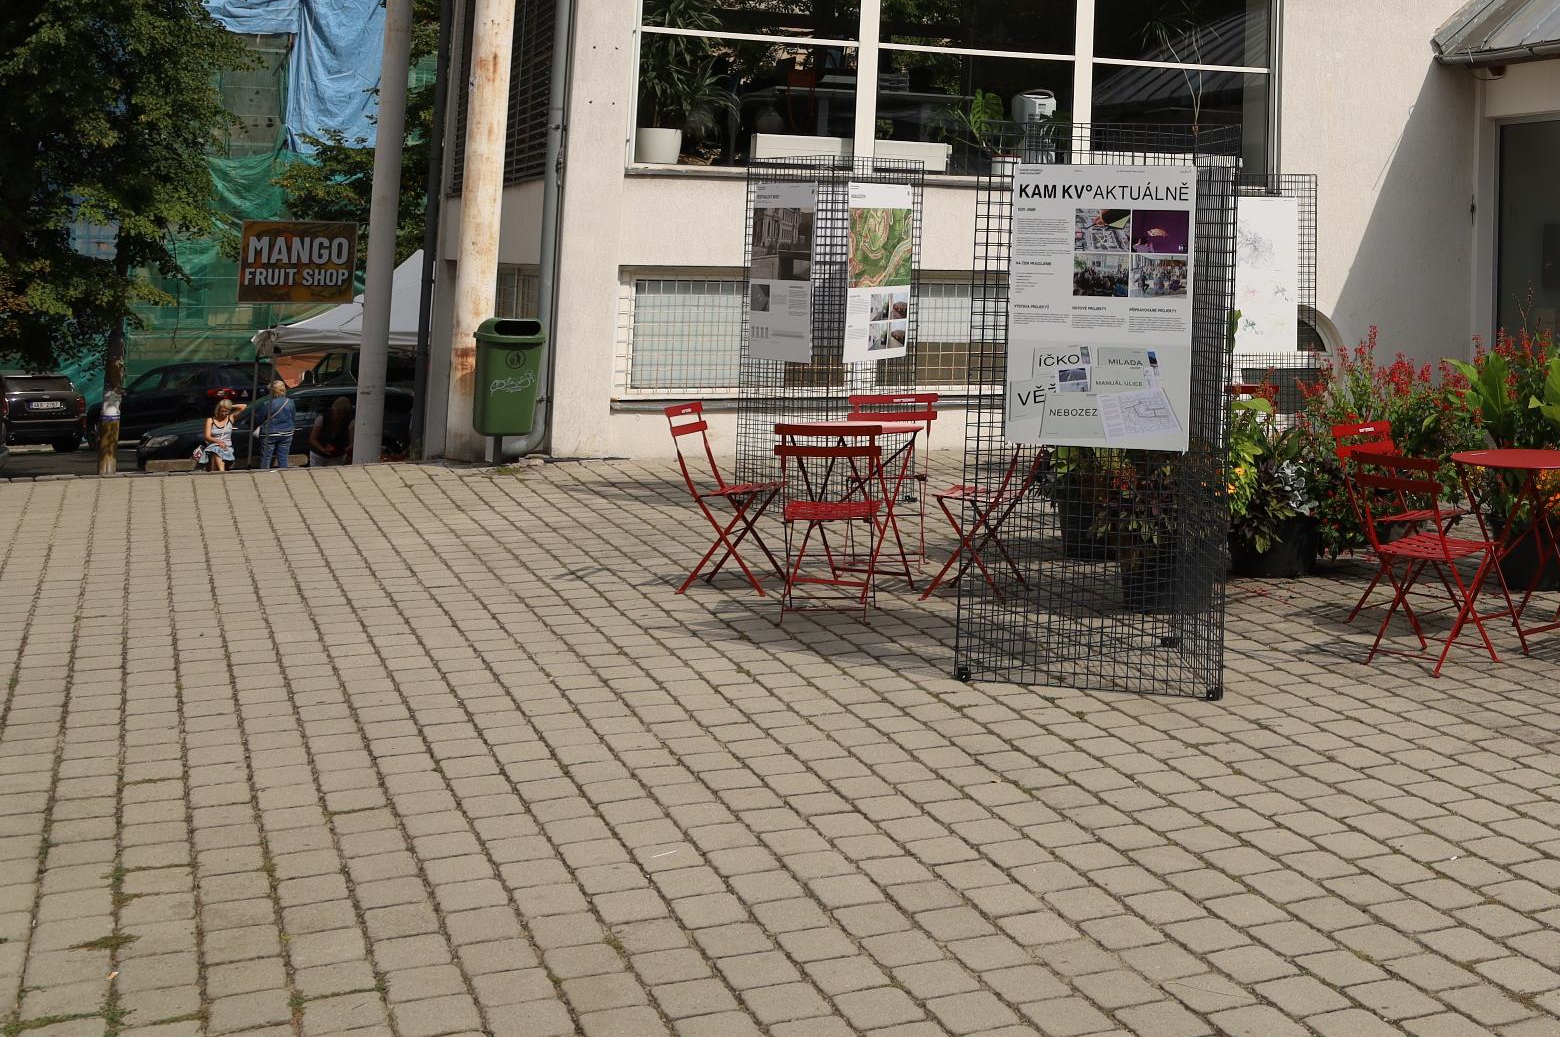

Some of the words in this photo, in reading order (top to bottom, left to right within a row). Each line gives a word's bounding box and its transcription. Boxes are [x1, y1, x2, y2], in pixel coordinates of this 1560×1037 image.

[1019, 183, 1057, 199] KAM
[247, 236, 349, 265] MANGO
[244, 268, 298, 286] FRUIT
[302, 268, 349, 286] SHOP
[1039, 353, 1080, 368] ÍČKO
[1108, 358, 1143, 366] MILADA
[1049, 408, 1099, 417] NEBOZEZ
